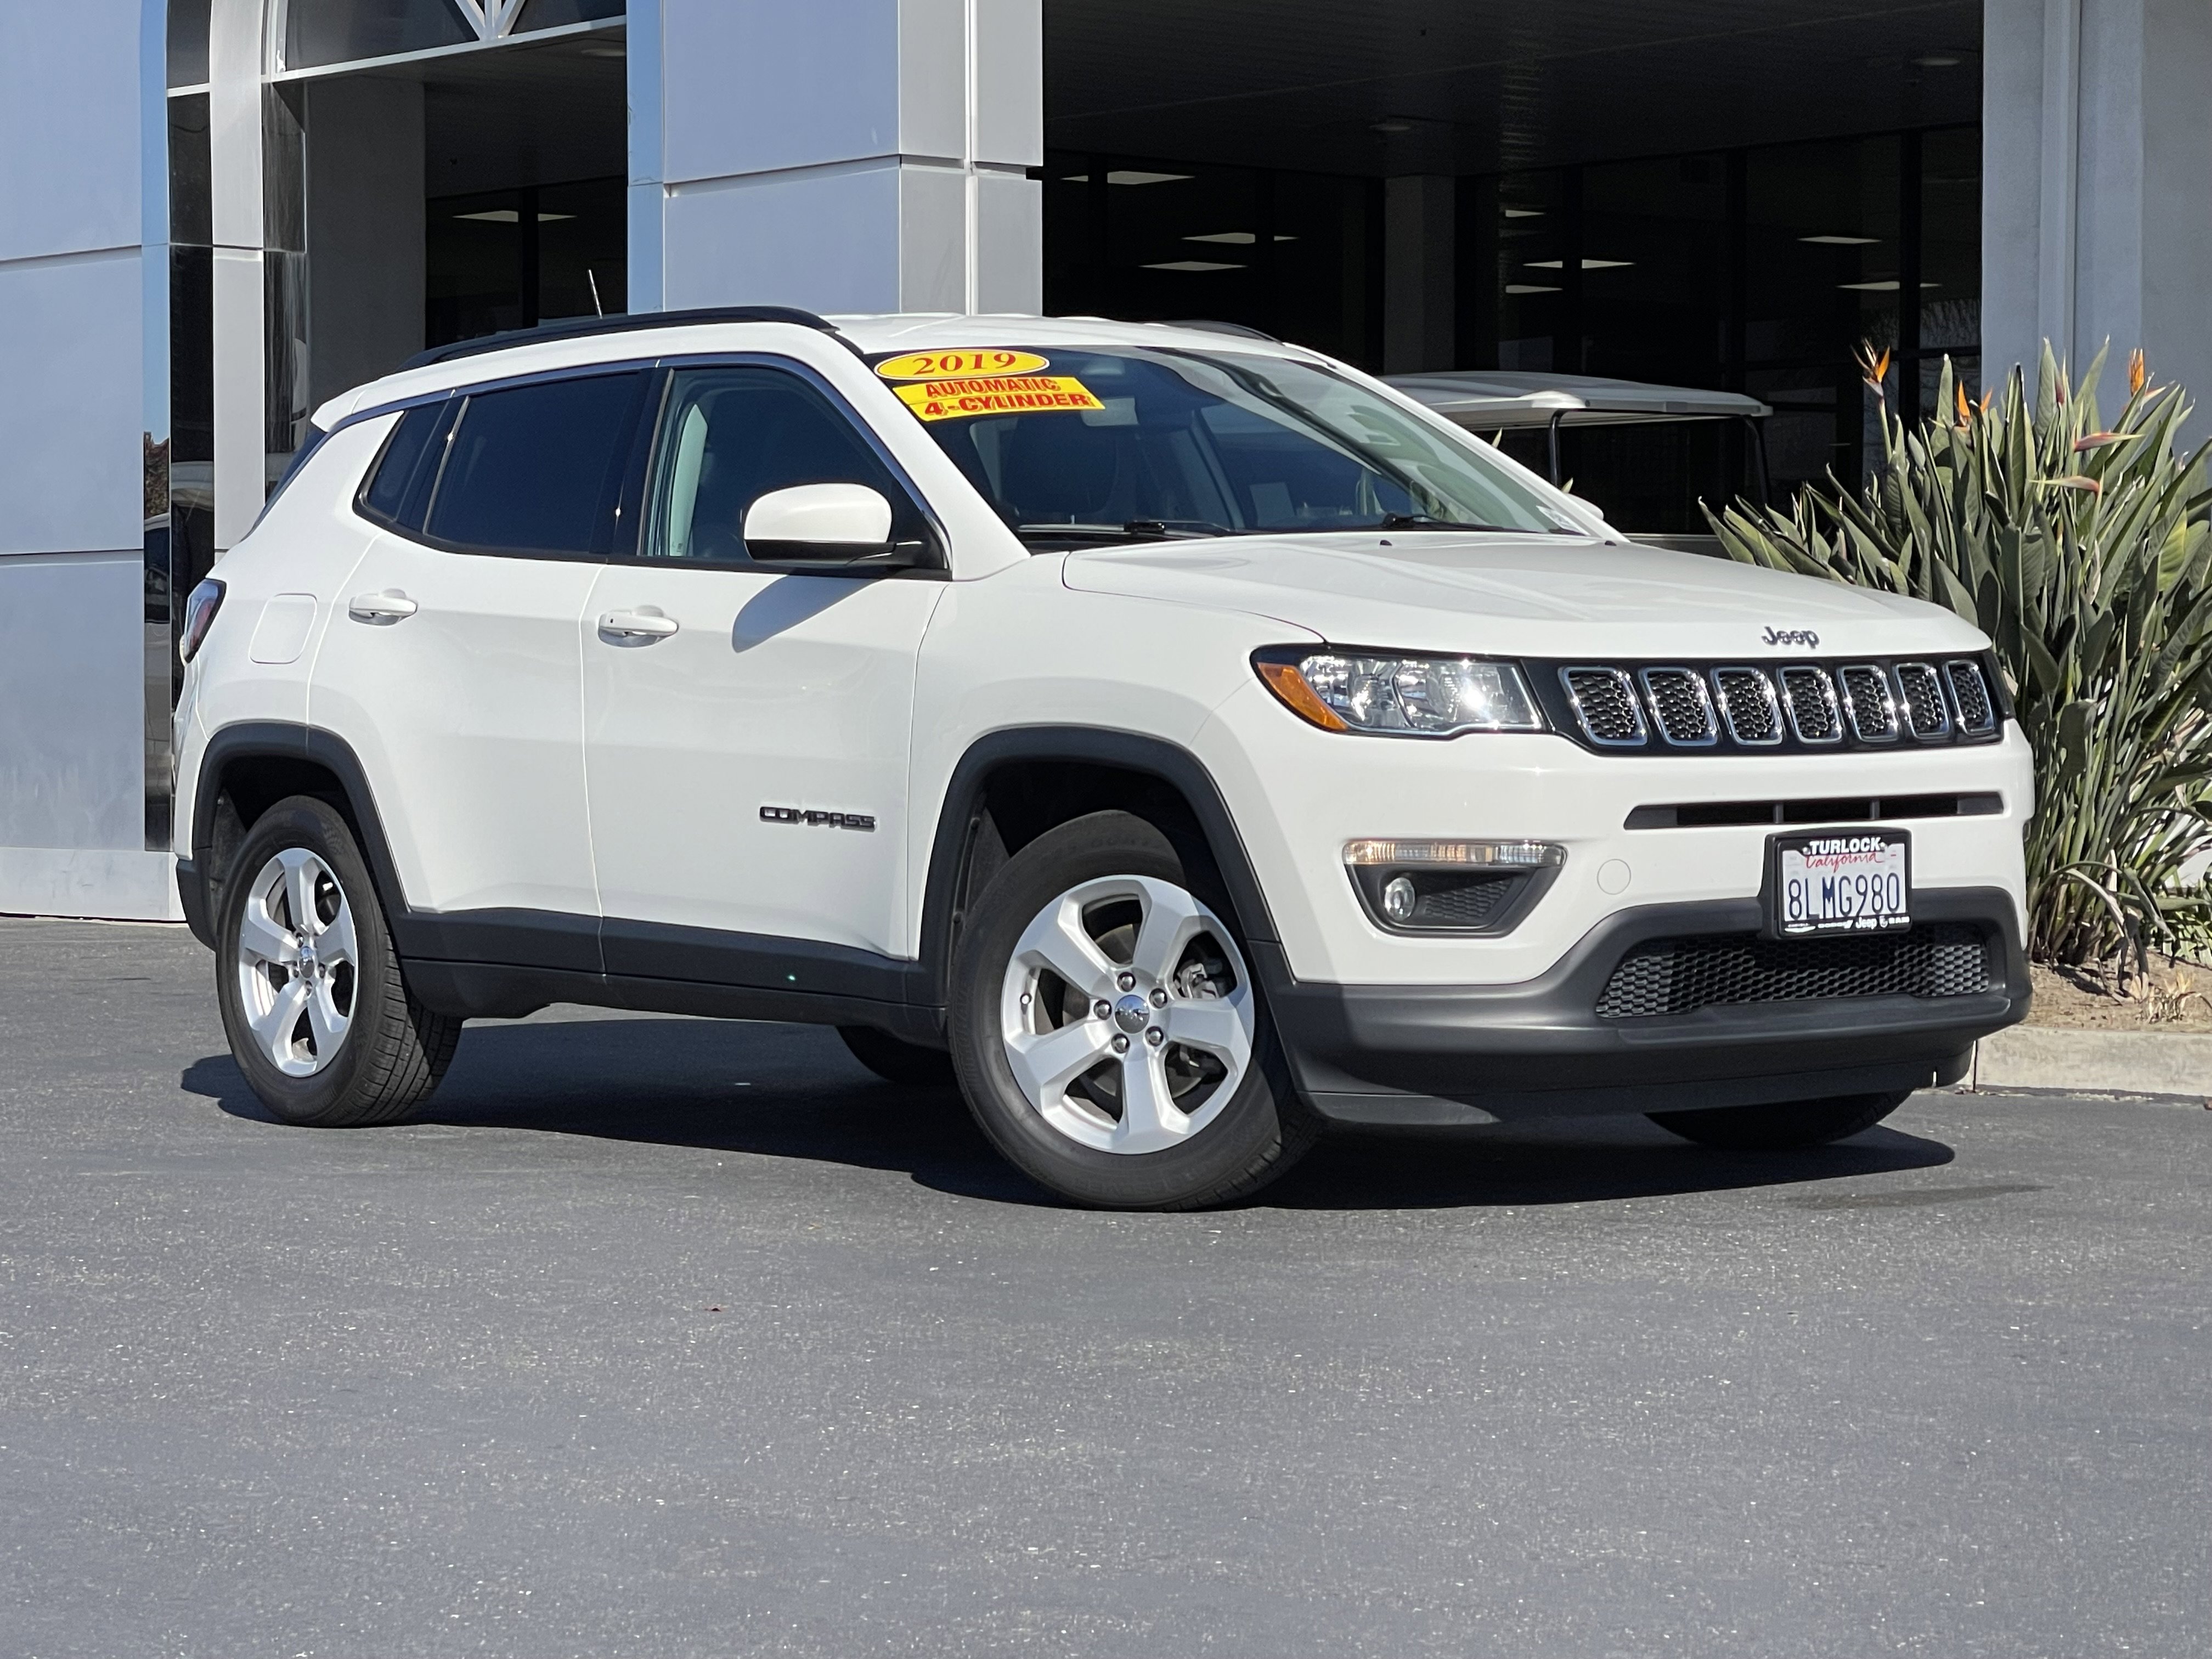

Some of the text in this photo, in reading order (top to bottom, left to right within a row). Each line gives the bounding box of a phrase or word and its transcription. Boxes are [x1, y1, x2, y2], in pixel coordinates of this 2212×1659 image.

[912, 353, 1016, 375] 2019
[926, 377, 1061, 398] AUTOMATIC
[924, 393, 1092, 415] 4-CYLINDER
[1761, 626, 1820, 650] Jeep
[760, 806, 877, 833] COMPASS
[1809, 837, 1881, 854] TURLOCK
[1805, 852, 1884, 873] California
[1788, 872, 1900, 920] 8LMG980
[1855, 917, 1878, 929] Jeep
